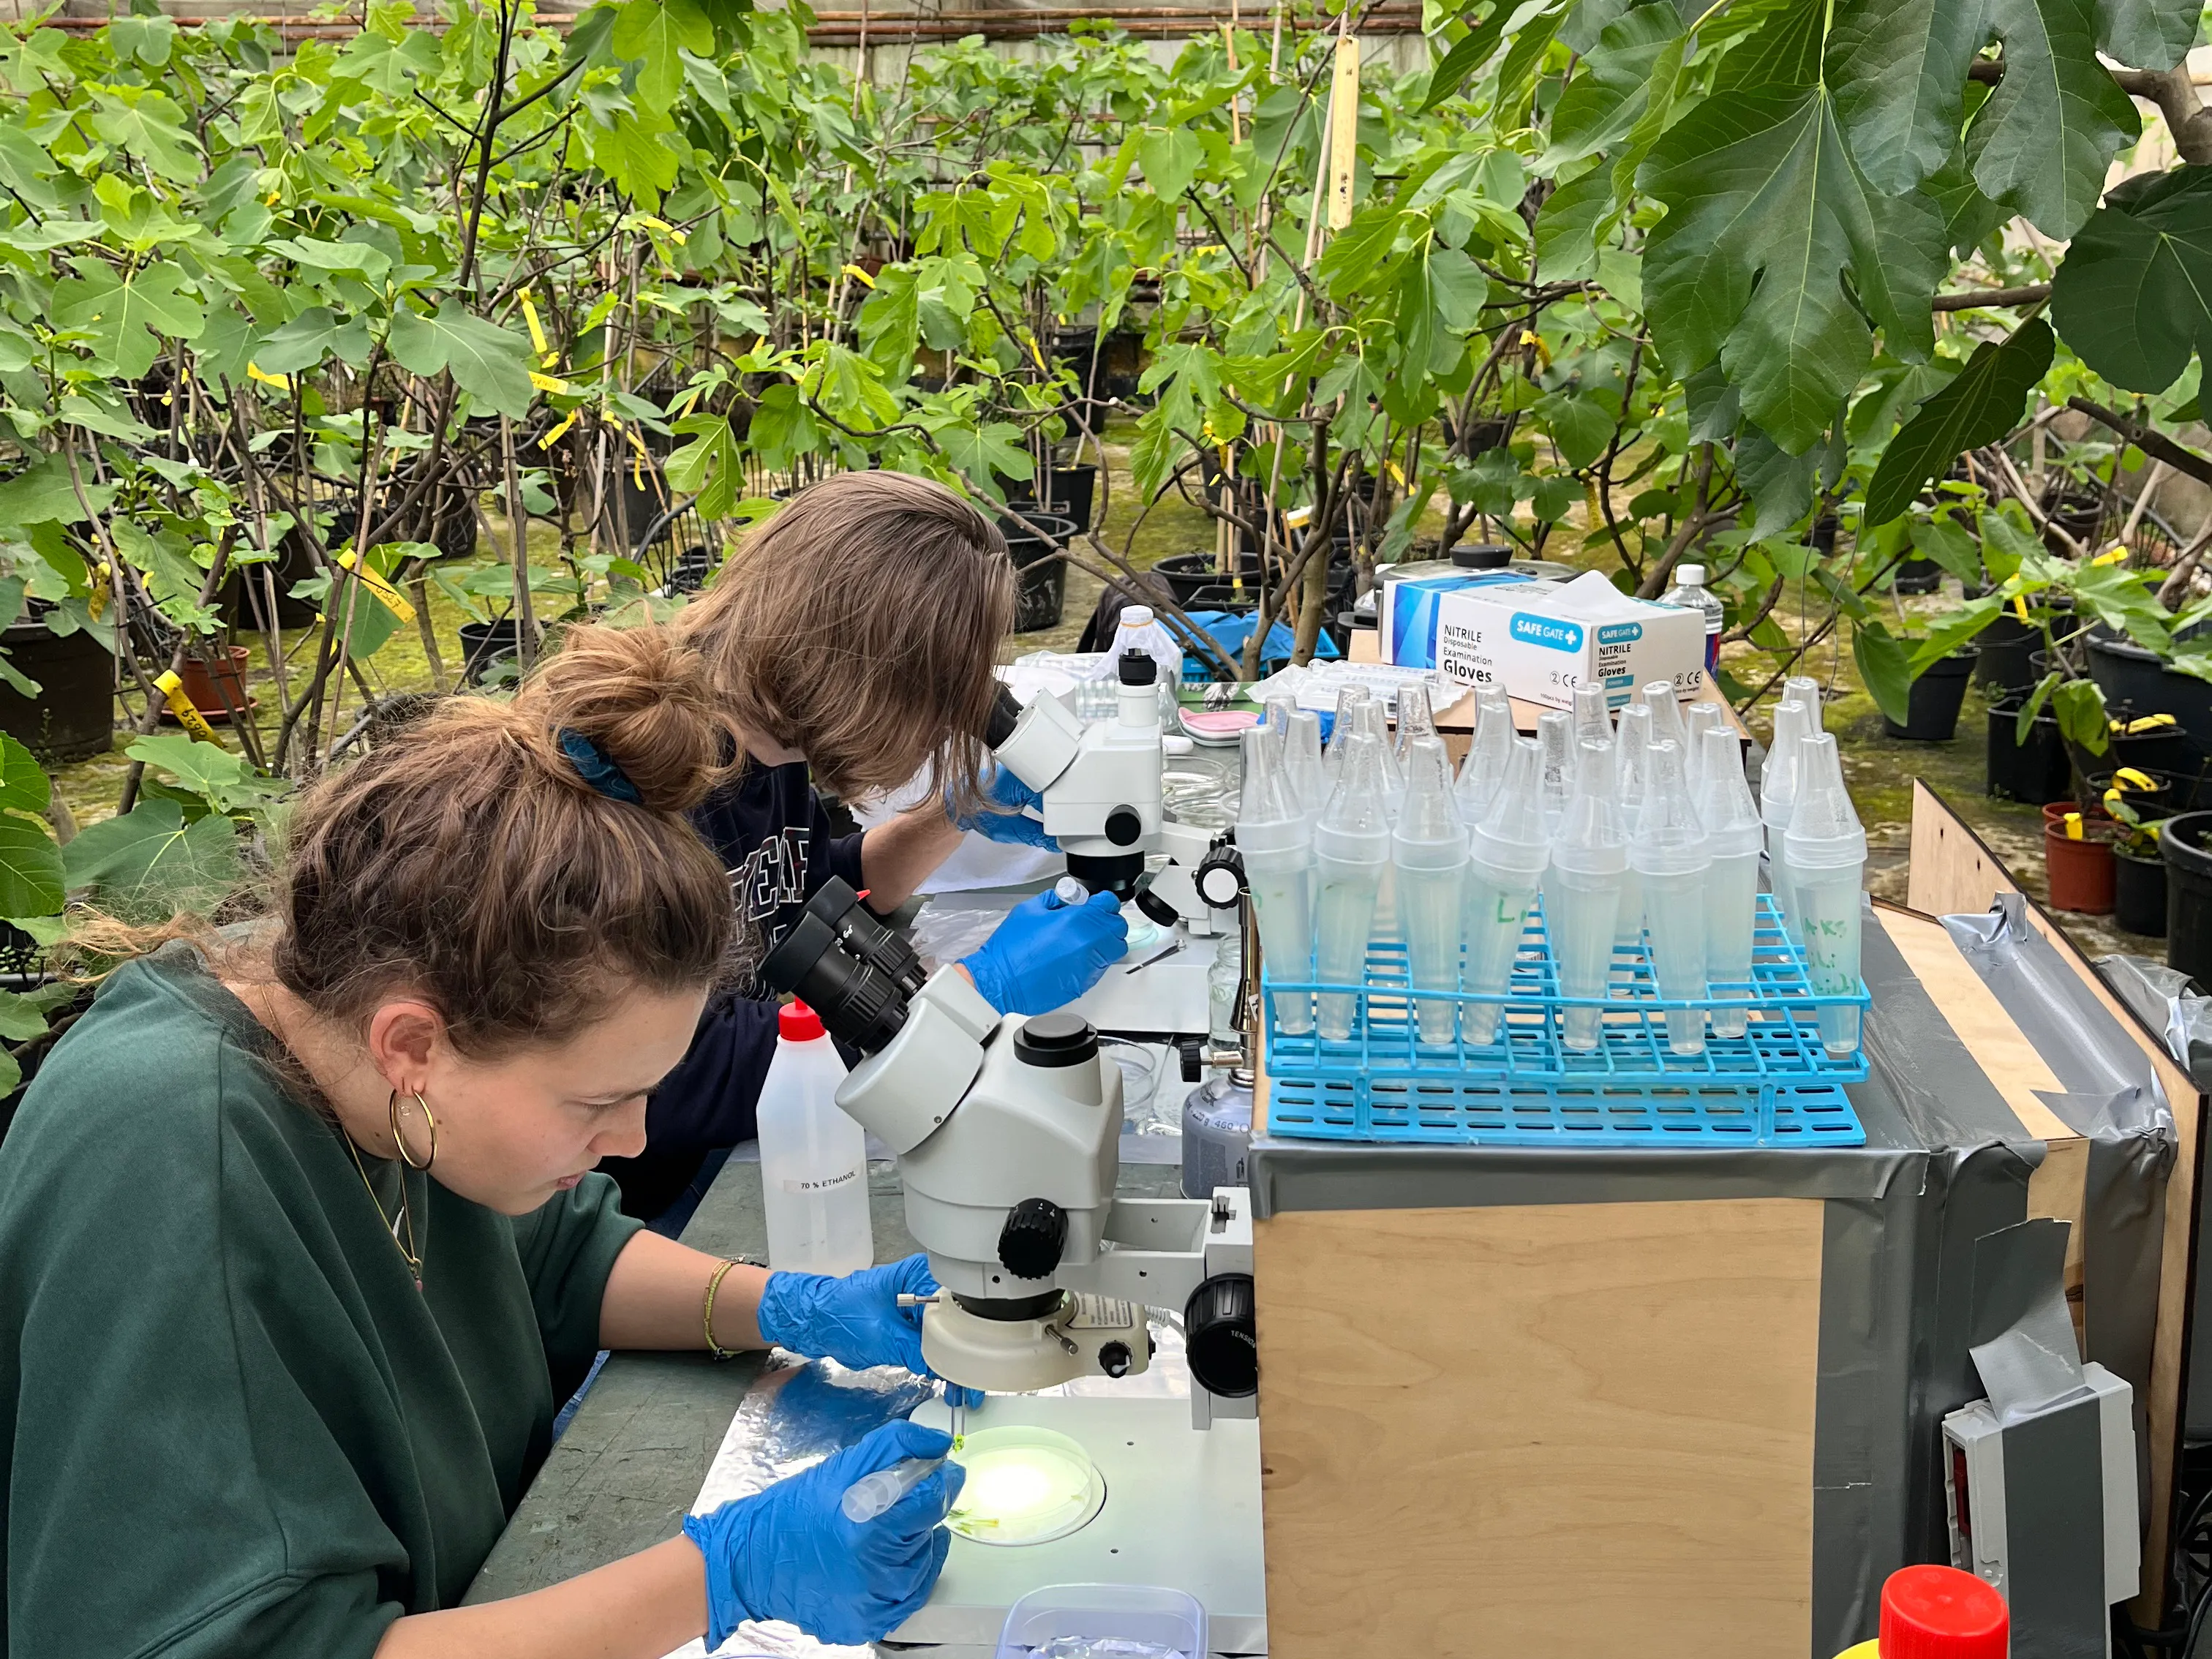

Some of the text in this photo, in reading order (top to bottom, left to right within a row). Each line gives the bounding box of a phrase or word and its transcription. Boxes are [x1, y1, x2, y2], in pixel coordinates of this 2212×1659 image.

[1445, 624, 1482, 643] NITRILE
[1516, 620, 1564, 640] SAFE GATE
[1601, 628, 1631, 639] SAFE GATE
[1443, 636, 1478, 650] Disposable
[1598, 644, 1631, 656] NITRILE
[1443, 647, 1493, 666] Examination
[1444, 659, 1492, 682] Gloves
[1598, 666, 1626, 677] Gloves
[181, 708, 208, 737] 0629
[822, 1170, 856, 1187] ETHANOL
